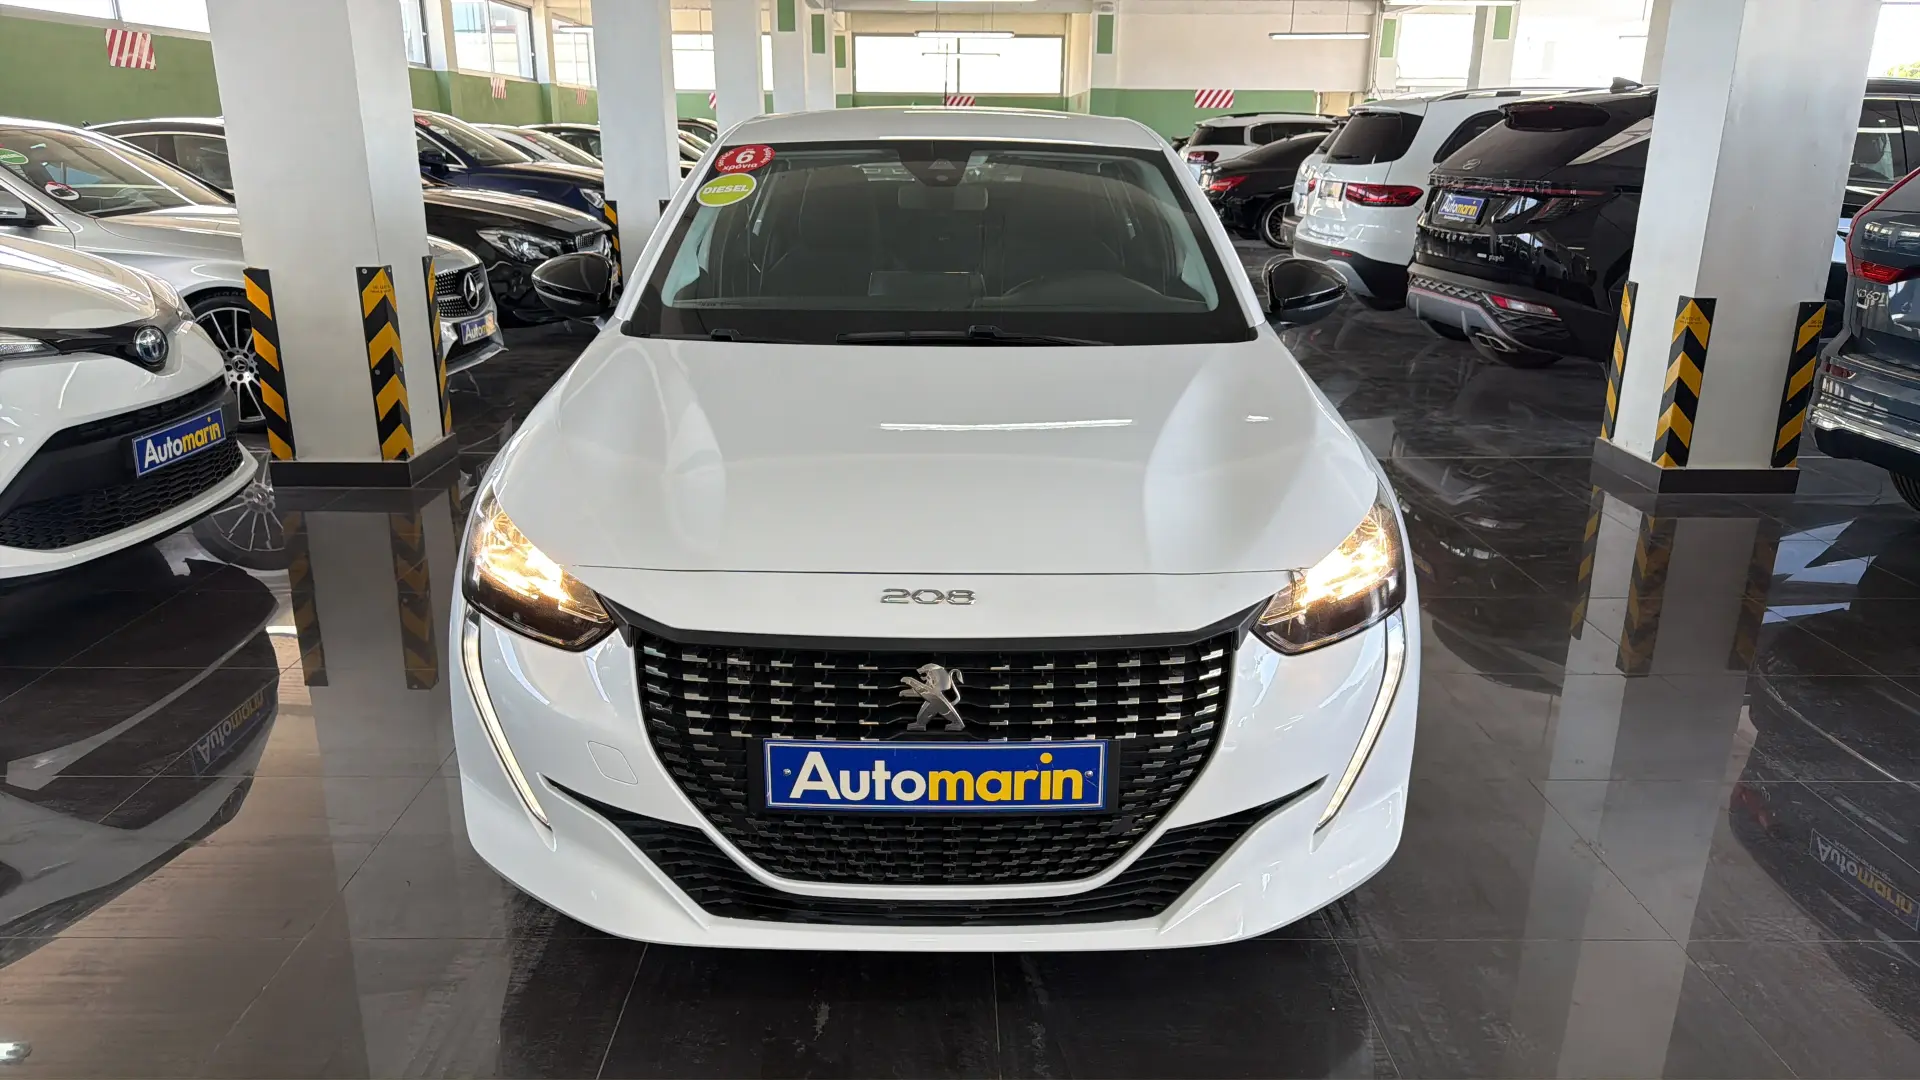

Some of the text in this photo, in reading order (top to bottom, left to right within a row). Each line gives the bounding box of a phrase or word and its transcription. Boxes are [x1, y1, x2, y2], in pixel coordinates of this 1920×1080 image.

[736, 151, 756, 164] 6
[702, 184, 749, 195] DIESEL
[1441, 197, 1477, 216] Automarin
[144, 416, 221, 469] Automarin
[880, 588, 976, 606] 208
[789, 751, 1083, 802] Automarin
